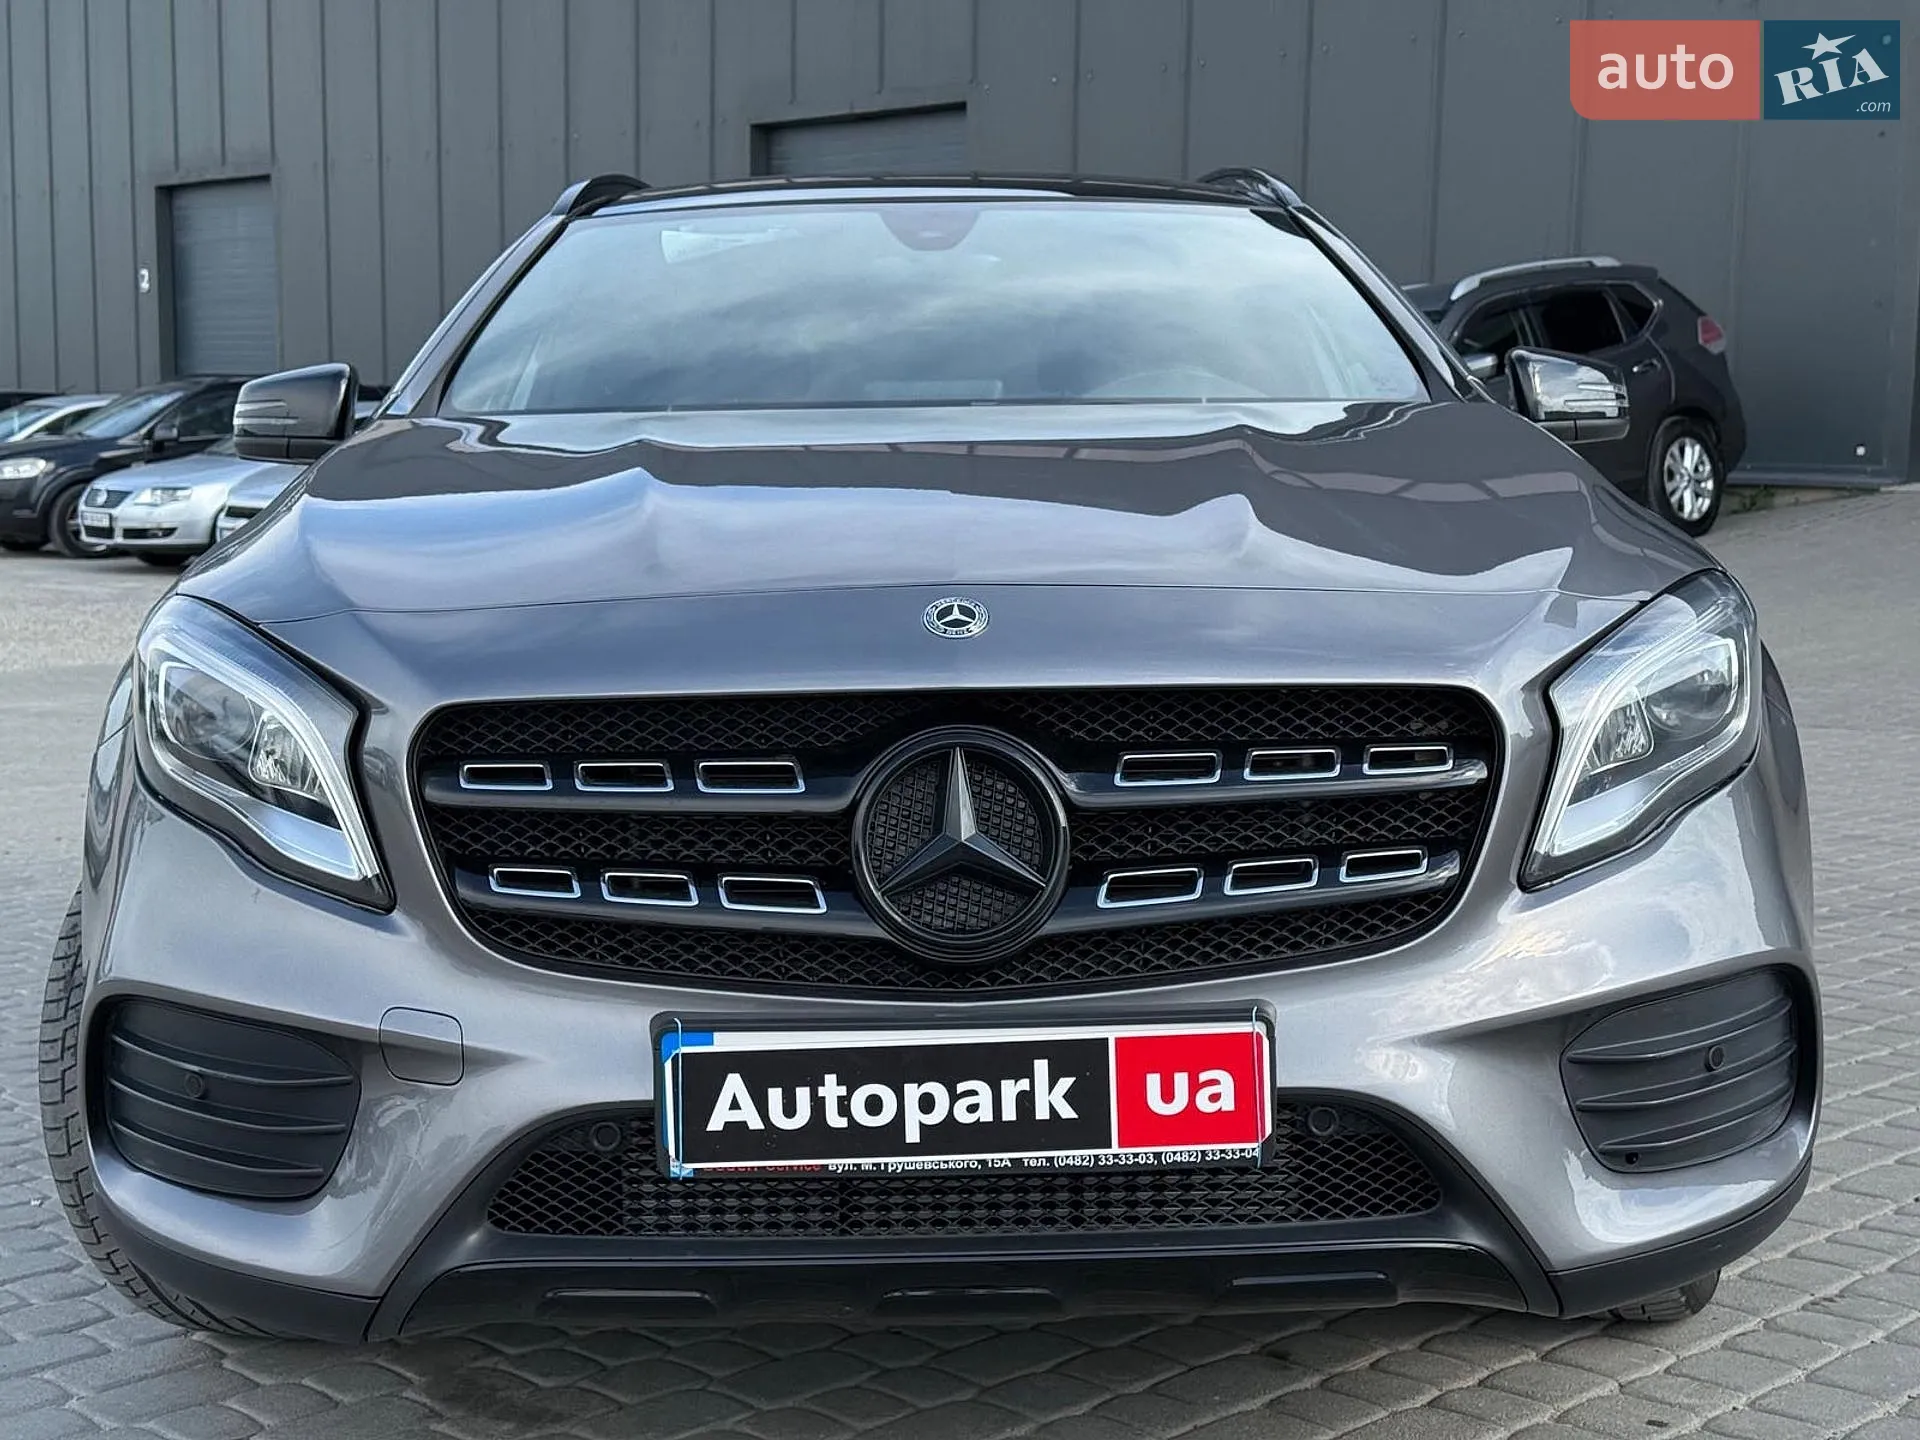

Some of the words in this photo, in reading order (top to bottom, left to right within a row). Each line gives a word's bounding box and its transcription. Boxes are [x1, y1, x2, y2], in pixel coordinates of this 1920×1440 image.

[706, 1059, 1080, 1144] Autopark
[1146, 1068, 1236, 1116] ua
[1022, 1157, 1050, 1167] тел.
[1054, 1155, 1095, 1167] (0482)
[1098, 1153, 1158, 1166] 33-33-03,
[1161, 1151, 1202, 1164] (0482)
